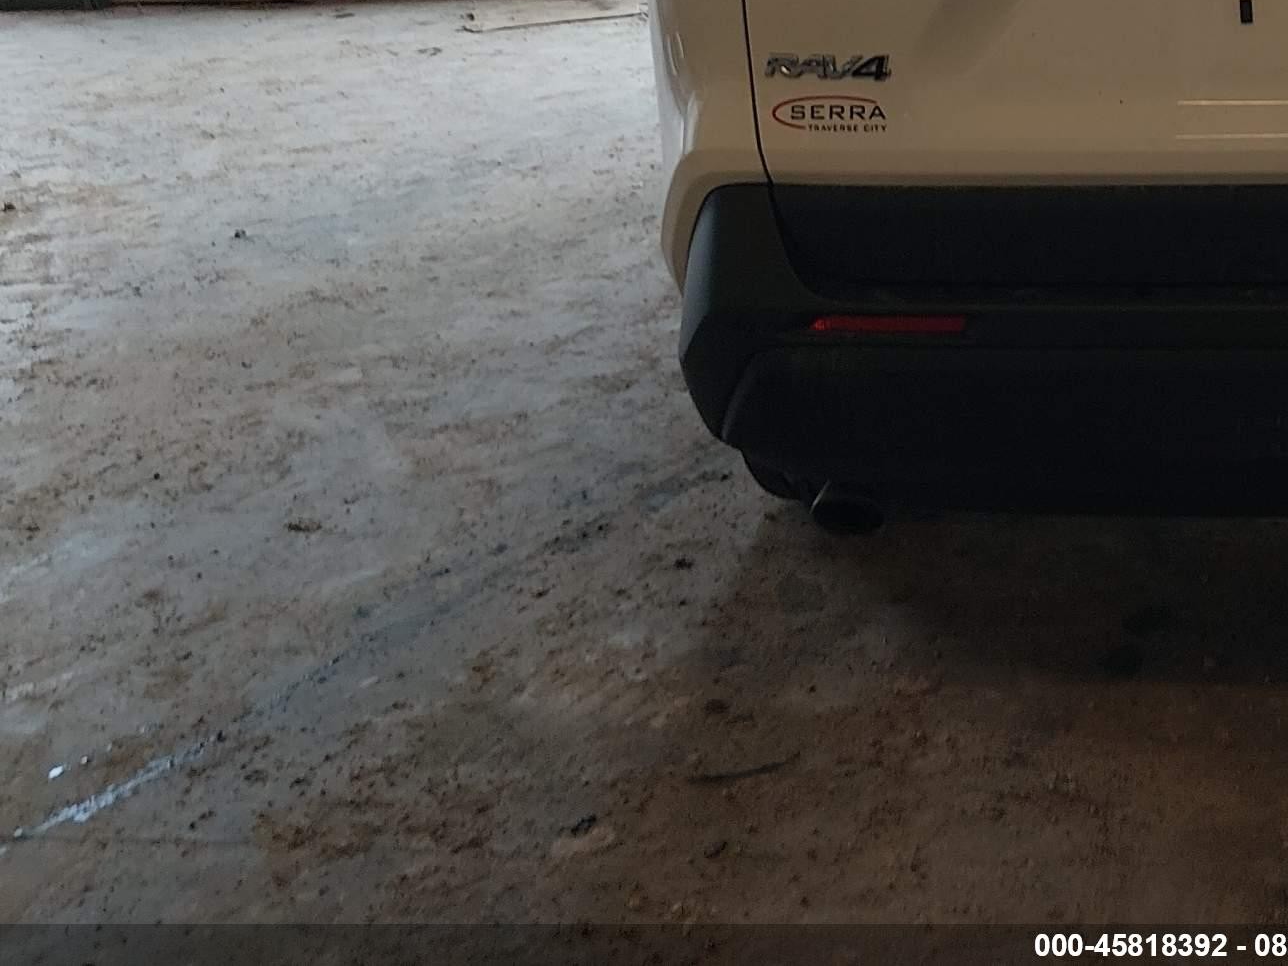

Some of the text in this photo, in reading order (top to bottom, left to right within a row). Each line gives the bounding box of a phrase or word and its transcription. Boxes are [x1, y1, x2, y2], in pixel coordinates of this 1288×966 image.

[765, 54, 892, 80] RAV4
[790, 104, 886, 120] SERRA
[808, 124, 887, 132] TRAVERSE CITY
